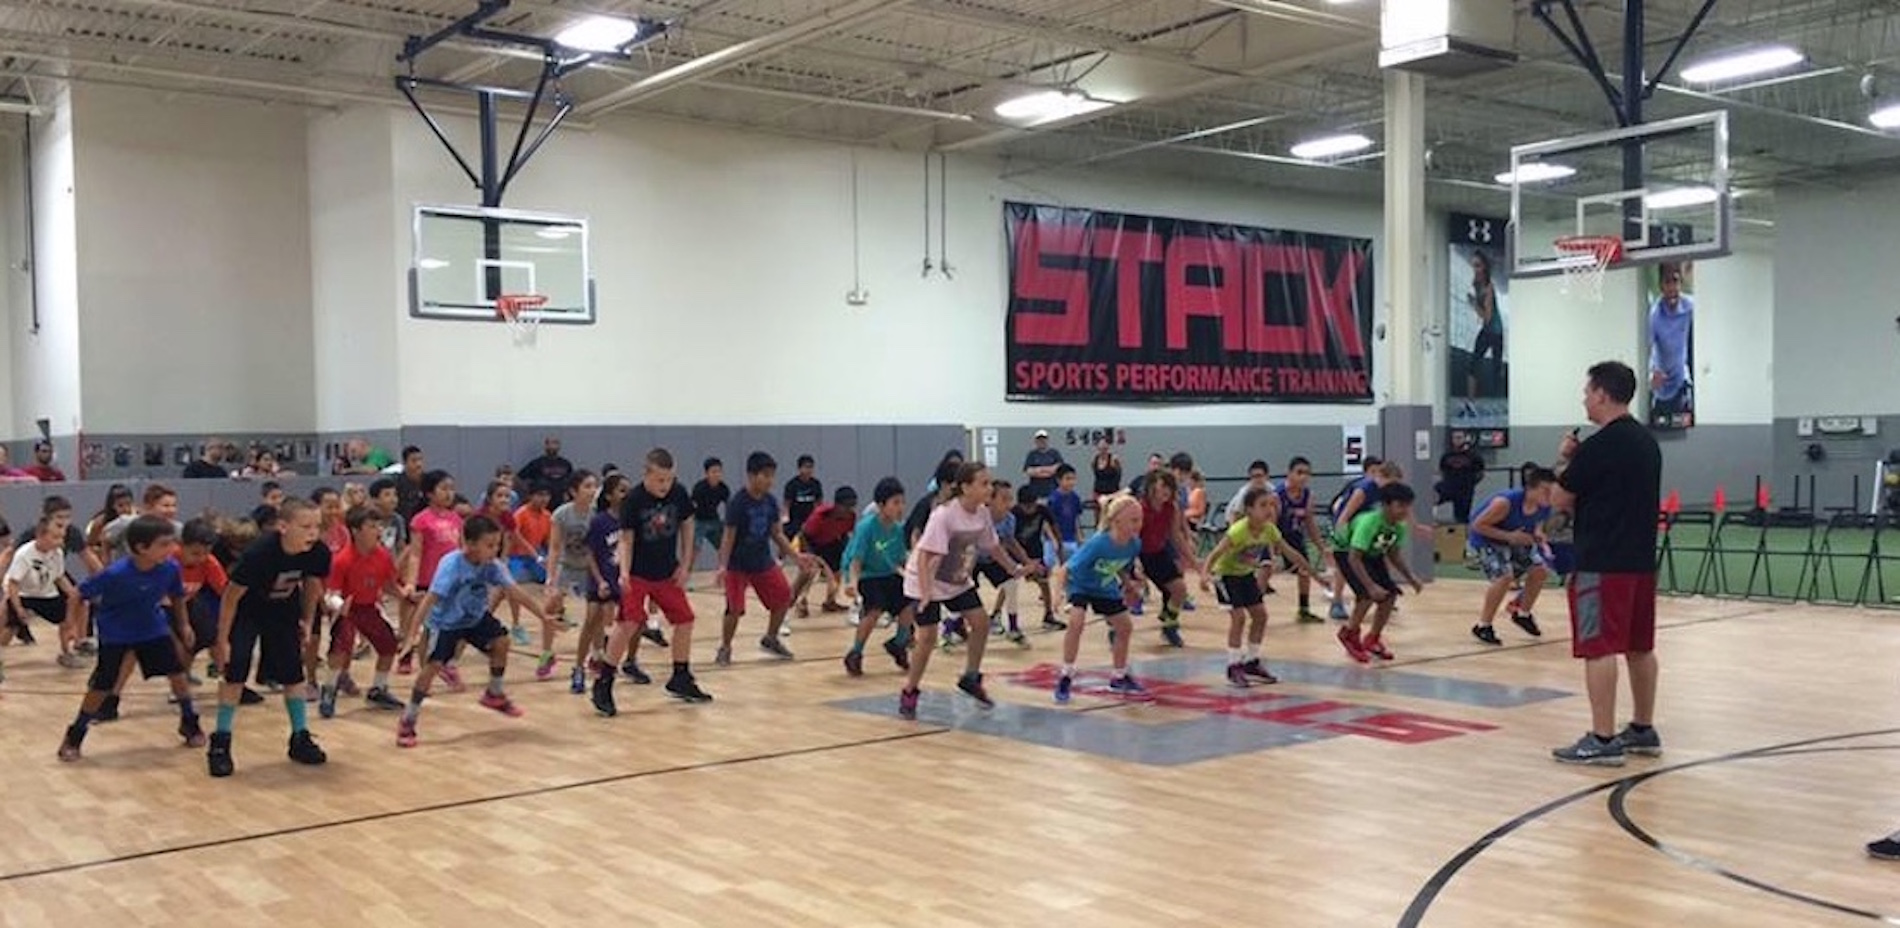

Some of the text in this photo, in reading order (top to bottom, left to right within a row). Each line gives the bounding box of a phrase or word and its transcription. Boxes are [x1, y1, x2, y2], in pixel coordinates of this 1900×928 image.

[1014, 220, 1365, 357] STACK
[1015, 361, 1367, 394] SPORTS PERFORMANCE TRAINING
